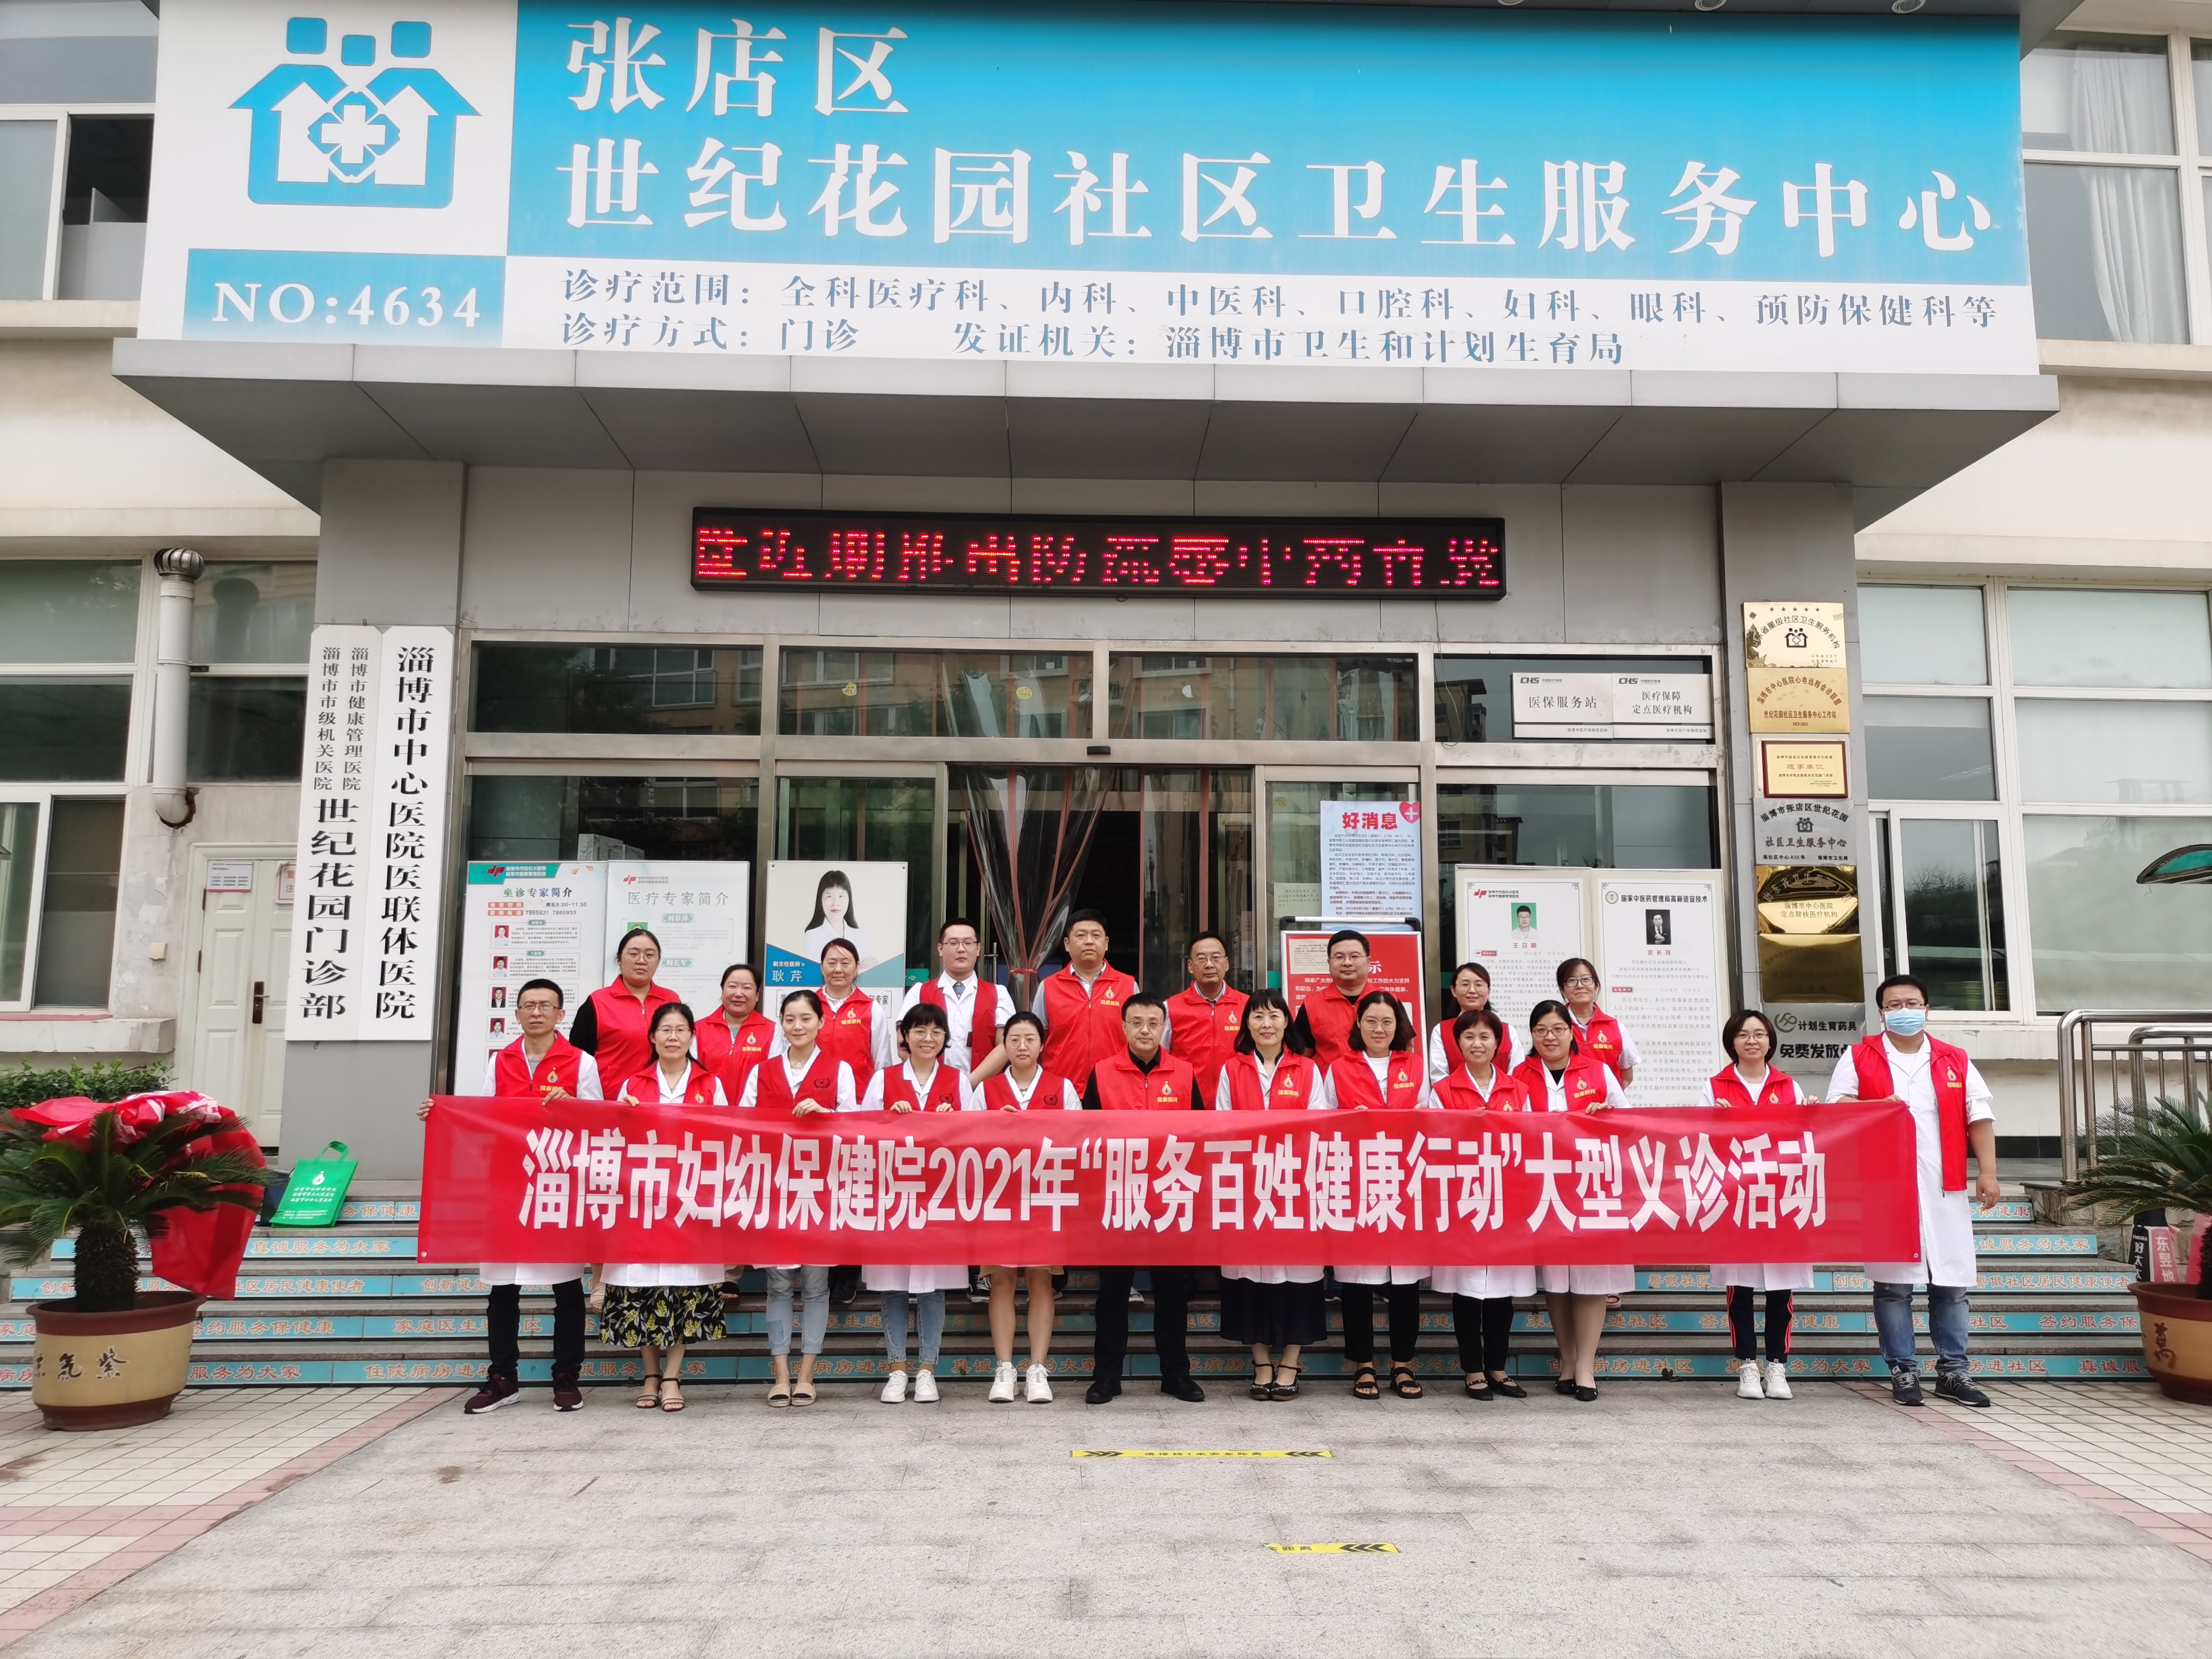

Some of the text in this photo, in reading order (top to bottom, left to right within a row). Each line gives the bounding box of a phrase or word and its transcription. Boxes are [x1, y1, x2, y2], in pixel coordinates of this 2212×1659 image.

[566, 16, 909, 116] 张店区
[556, 137, 1991, 258] 世纪花园社区卫生服务中心
[212, 283, 480, 328] NO:4634
[1529, 695, 1597, 709] 医保服务站
[1642, 691, 1681, 700] 医疗保障
[1632, 704, 1692, 715] 定点医疗机构
[313, 646, 340, 791] 淄博市市级机关医院
[342, 646, 369, 791] 淄博市健康管理医院
[1760, 803, 1849, 823] 淄博市张店区世纪花园
[1342, 812, 1398, 830] 好消息
[375, 646, 435, 1021] 淄博市中心医院医联体医院
[1765, 836, 1847, 850] 社区卫生服务中心
[503, 887, 572, 897] 坐诊专家简介
[628, 891, 729, 905] 医疗专家简介
[1621, 894, 1708, 903] 国家中医药管理局高新适宜技术
[300, 798, 360, 1020] 世纪花园门诊部
[773, 970, 802, 982] 耿芹
[1798, 1021, 1857, 1031] 计划生育药具
[517, 1127, 1826, 1235] 淄博市妇幼保健院2021年“服务百姓健康行动”大型义诊活动
[252, 1241, 391, 1254] 真诚服务为大家
[1974, 1238, 2090, 1252] 诚服务为大家
[2079, 1359, 2149, 1373] 真诚服
